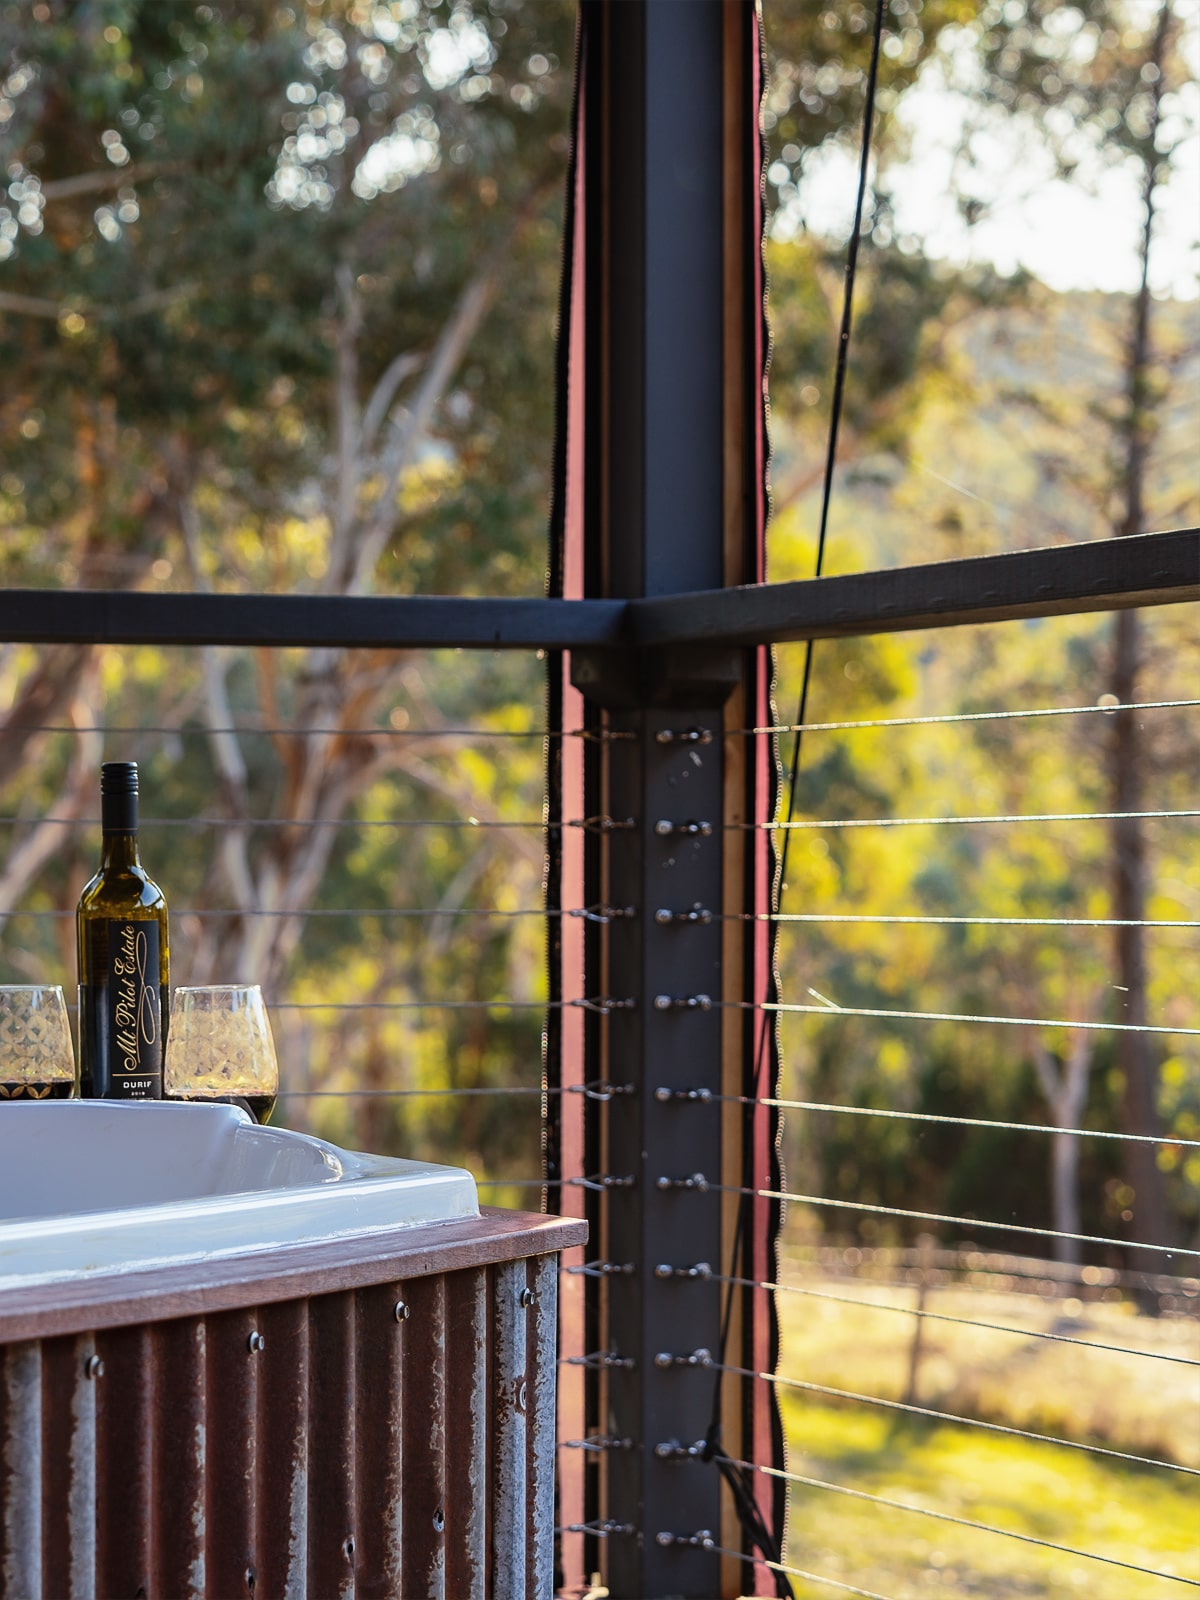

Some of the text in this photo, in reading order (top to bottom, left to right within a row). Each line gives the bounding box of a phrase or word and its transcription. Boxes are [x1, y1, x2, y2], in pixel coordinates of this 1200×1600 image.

[114, 925, 137, 975] Estate
[115, 978, 137, 1027] Pilot
[116, 1029, 137, 1071] Mt
[123, 1081, 152, 1089] DURIF
